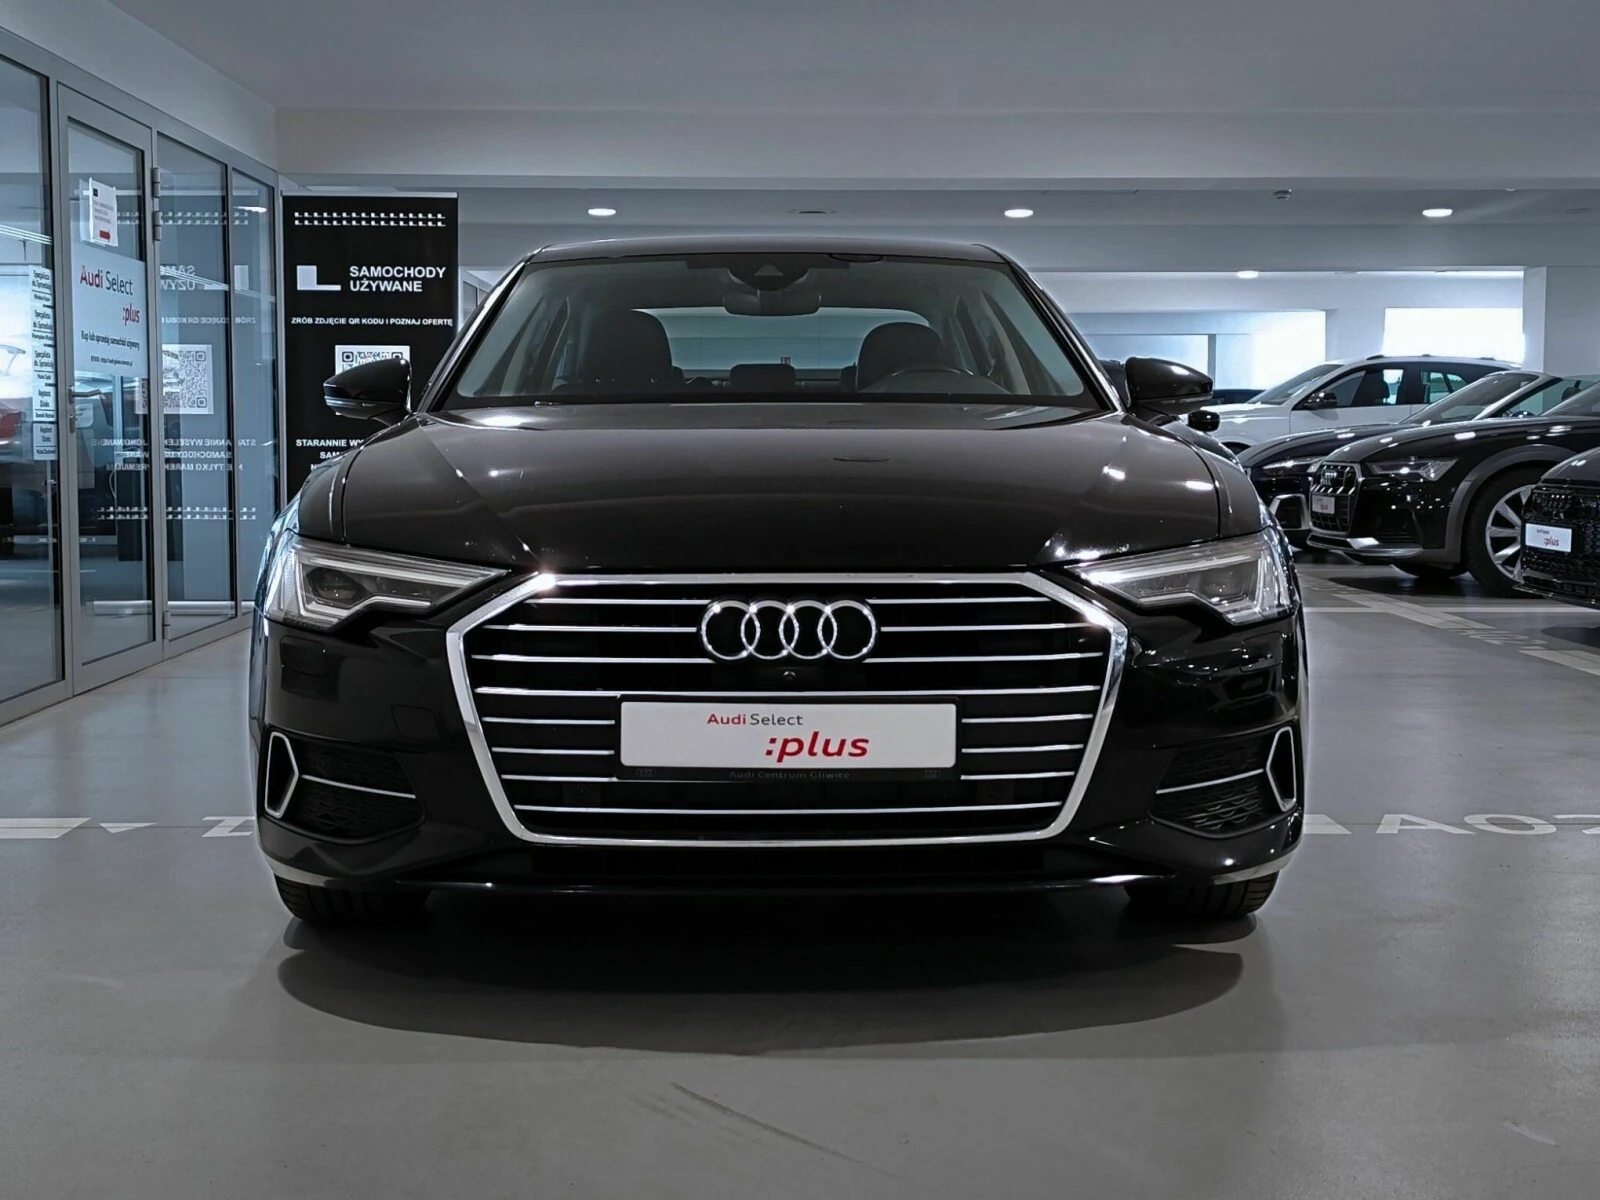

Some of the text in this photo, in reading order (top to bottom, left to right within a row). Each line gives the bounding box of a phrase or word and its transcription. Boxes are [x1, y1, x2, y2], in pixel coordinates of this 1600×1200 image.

[349, 265, 446, 279] SAMOCHODY
[80, 265, 133, 296] Audi Select
[349, 278, 423, 292] UŻYWANE
[122, 303, 140, 326] :plus
[291, 316, 313, 325] ZRÓB
[314, 317, 347, 326] ZDJĘCIE
[348, 317, 361, 325] QR
[362, 317, 385, 325] KODU
[390, 318, 421, 326] POZNAJ
[422, 318, 453, 327] OFERTĘ
[295, 438, 348, 447] STARANNIE
[706, 713, 804, 726] Audi Select
[764, 731, 870, 763] :plus
